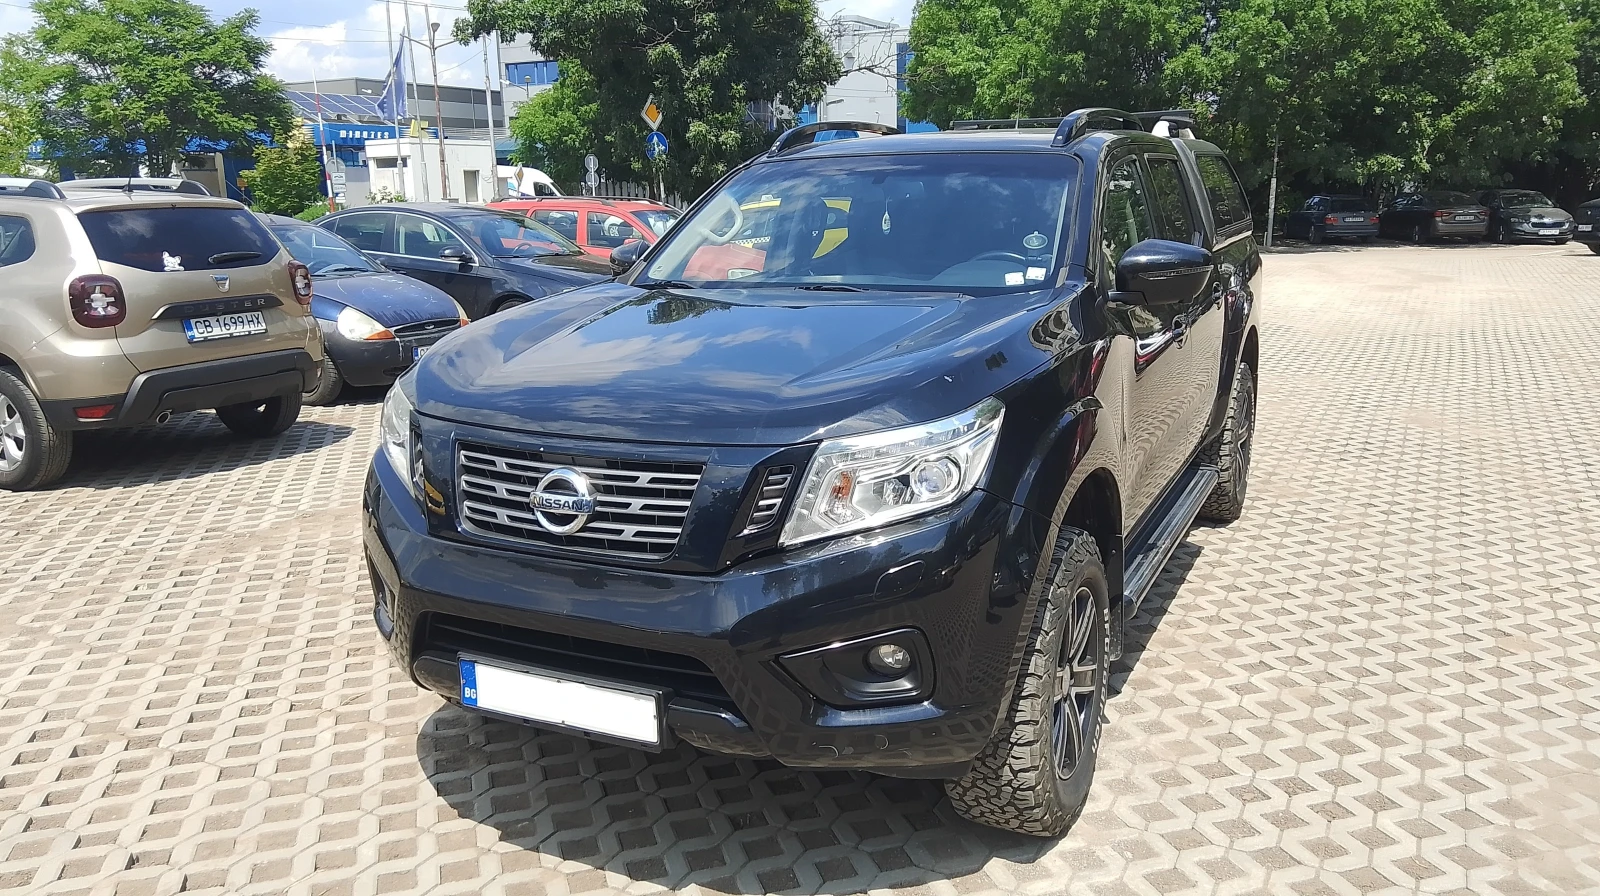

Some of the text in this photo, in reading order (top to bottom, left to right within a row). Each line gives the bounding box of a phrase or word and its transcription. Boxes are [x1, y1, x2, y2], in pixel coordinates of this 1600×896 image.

[340, 130, 389, 139] MINUTES
[185, 298, 266, 313] DUSTER
[194, 319, 213, 335] CB
[215, 315, 245, 332] 1699
[245, 313, 263, 328] HX
[533, 495, 583, 511] NISSAN
[464, 687, 477, 700] BG
